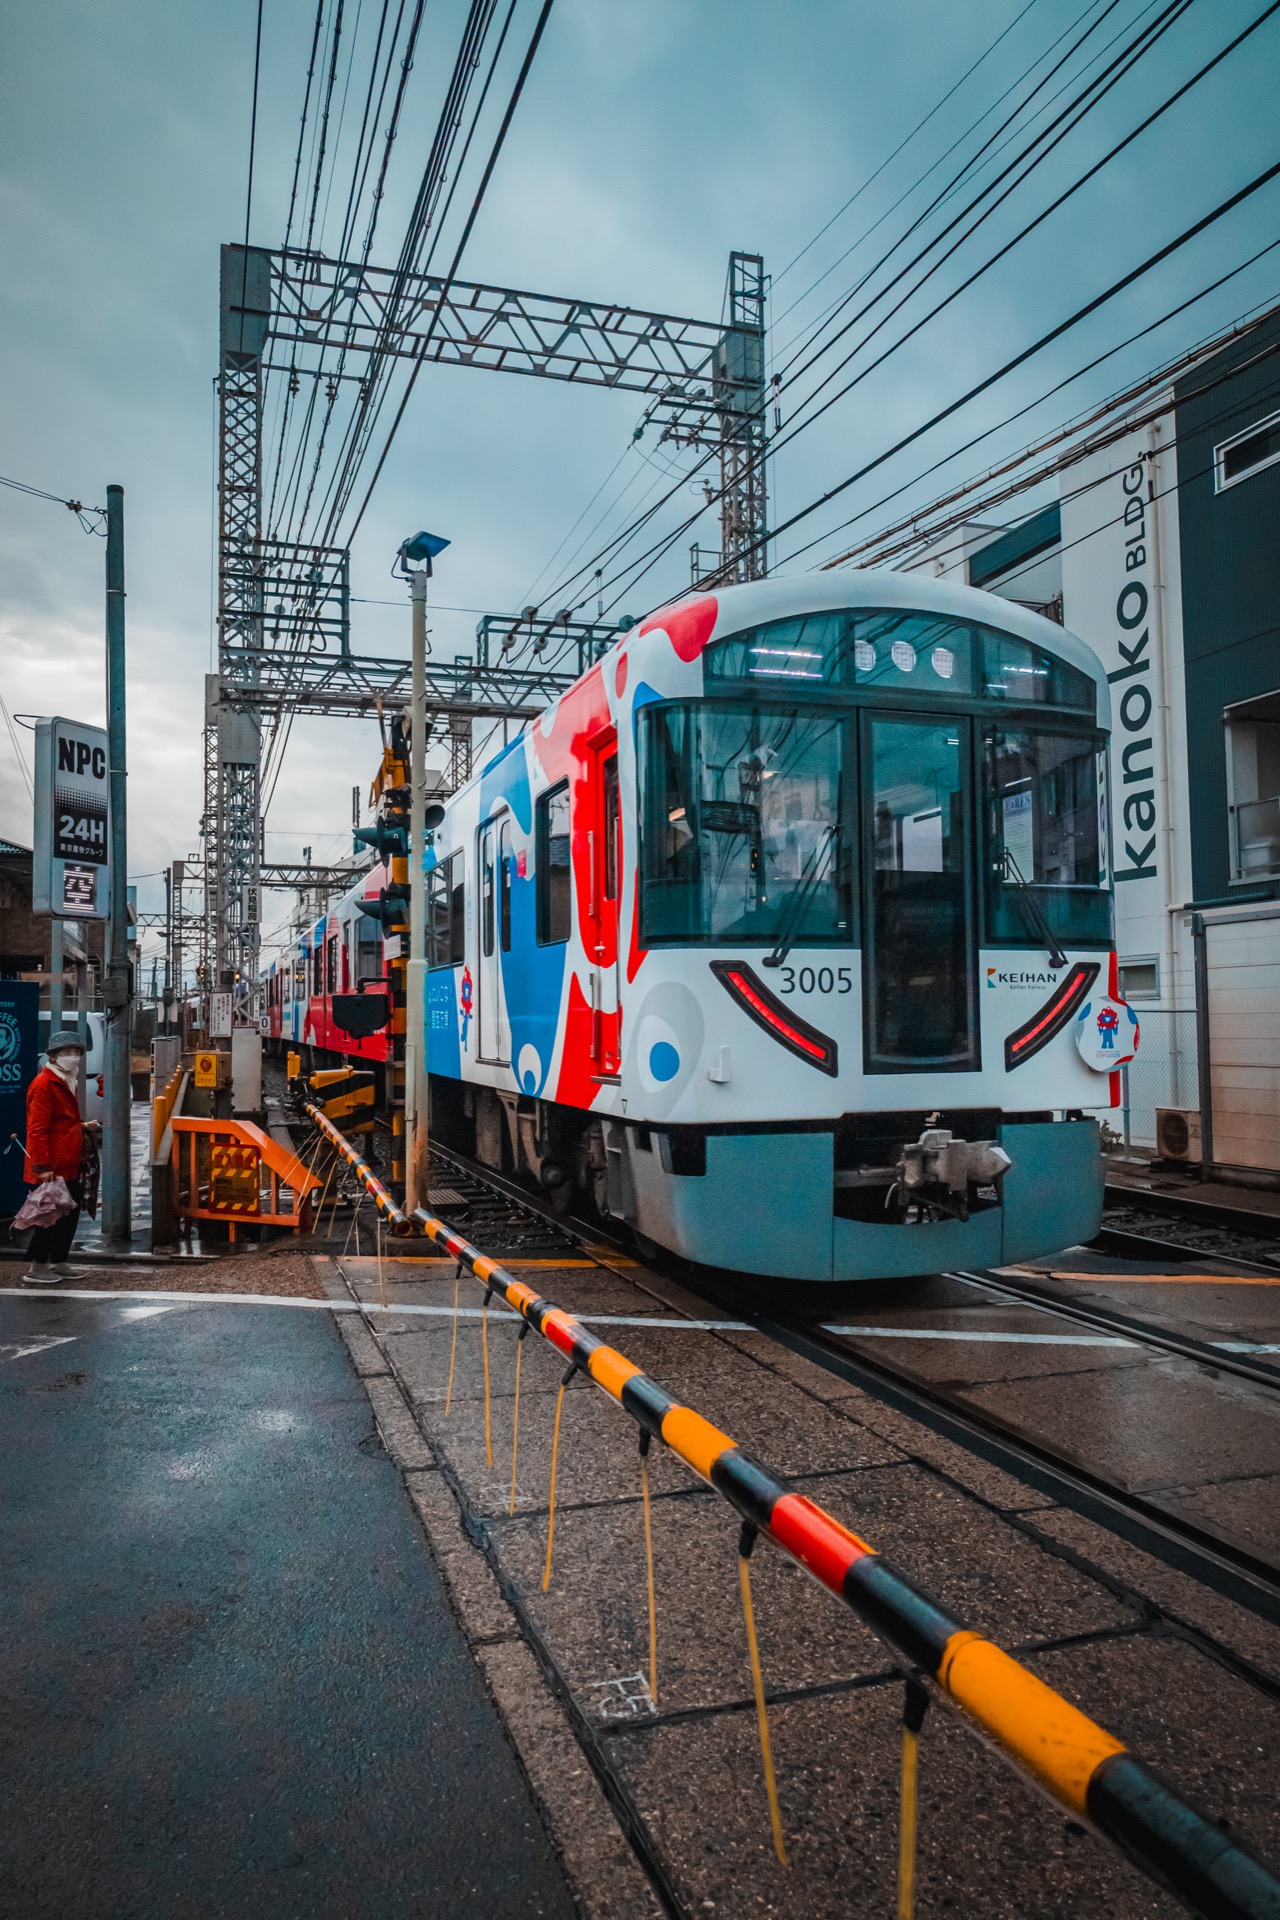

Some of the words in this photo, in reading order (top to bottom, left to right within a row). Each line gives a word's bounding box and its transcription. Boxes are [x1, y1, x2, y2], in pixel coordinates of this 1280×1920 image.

[1122, 450, 1147, 573] BLDG.
[1107, 580, 1158, 883] kanoko
[58, 737, 106, 780] NPC
[59, 815, 104, 843] 24H
[60, 843, 104, 857] 東京建物グループ
[63, 866, 94, 910] 空
[247, 887, 258, 921] 伏見稲荷
[780, 967, 852, 994] 3005
[261, 1017, 268, 1028] 0
[0, 1063, 21, 1082] SS
